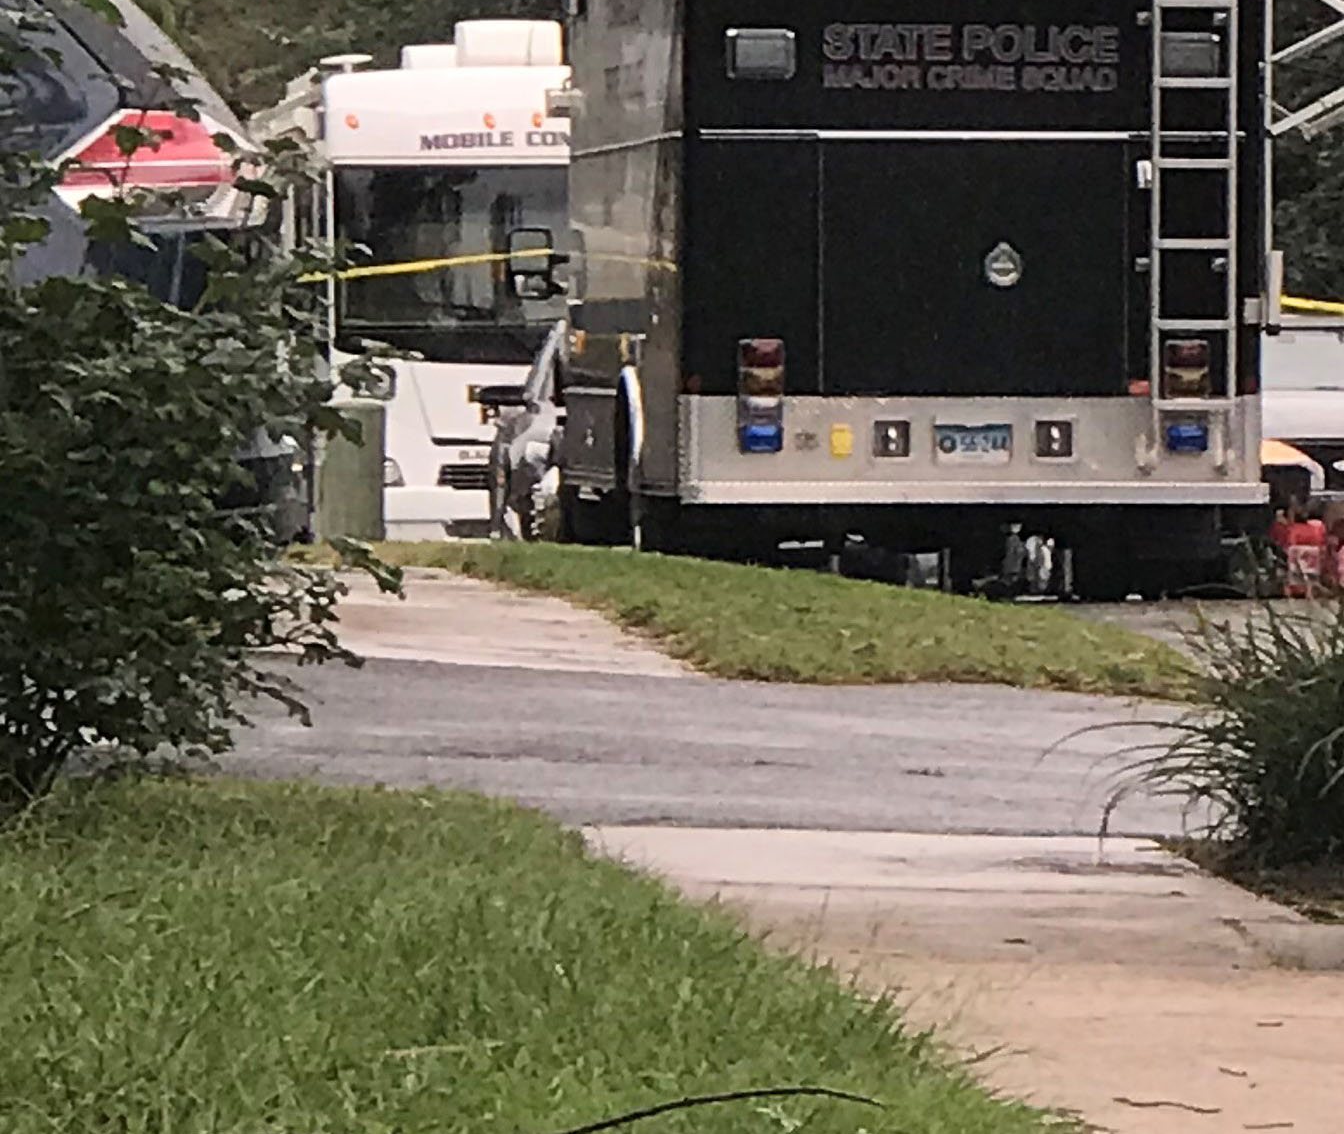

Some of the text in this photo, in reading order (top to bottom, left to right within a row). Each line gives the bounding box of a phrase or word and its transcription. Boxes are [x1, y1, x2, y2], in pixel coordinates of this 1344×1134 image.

[822, 22, 1119, 63] STATE POLICE
[822, 66, 1118, 92] MAJOR CRIME SQUAD
[420, 131, 513, 150] MOBILE
